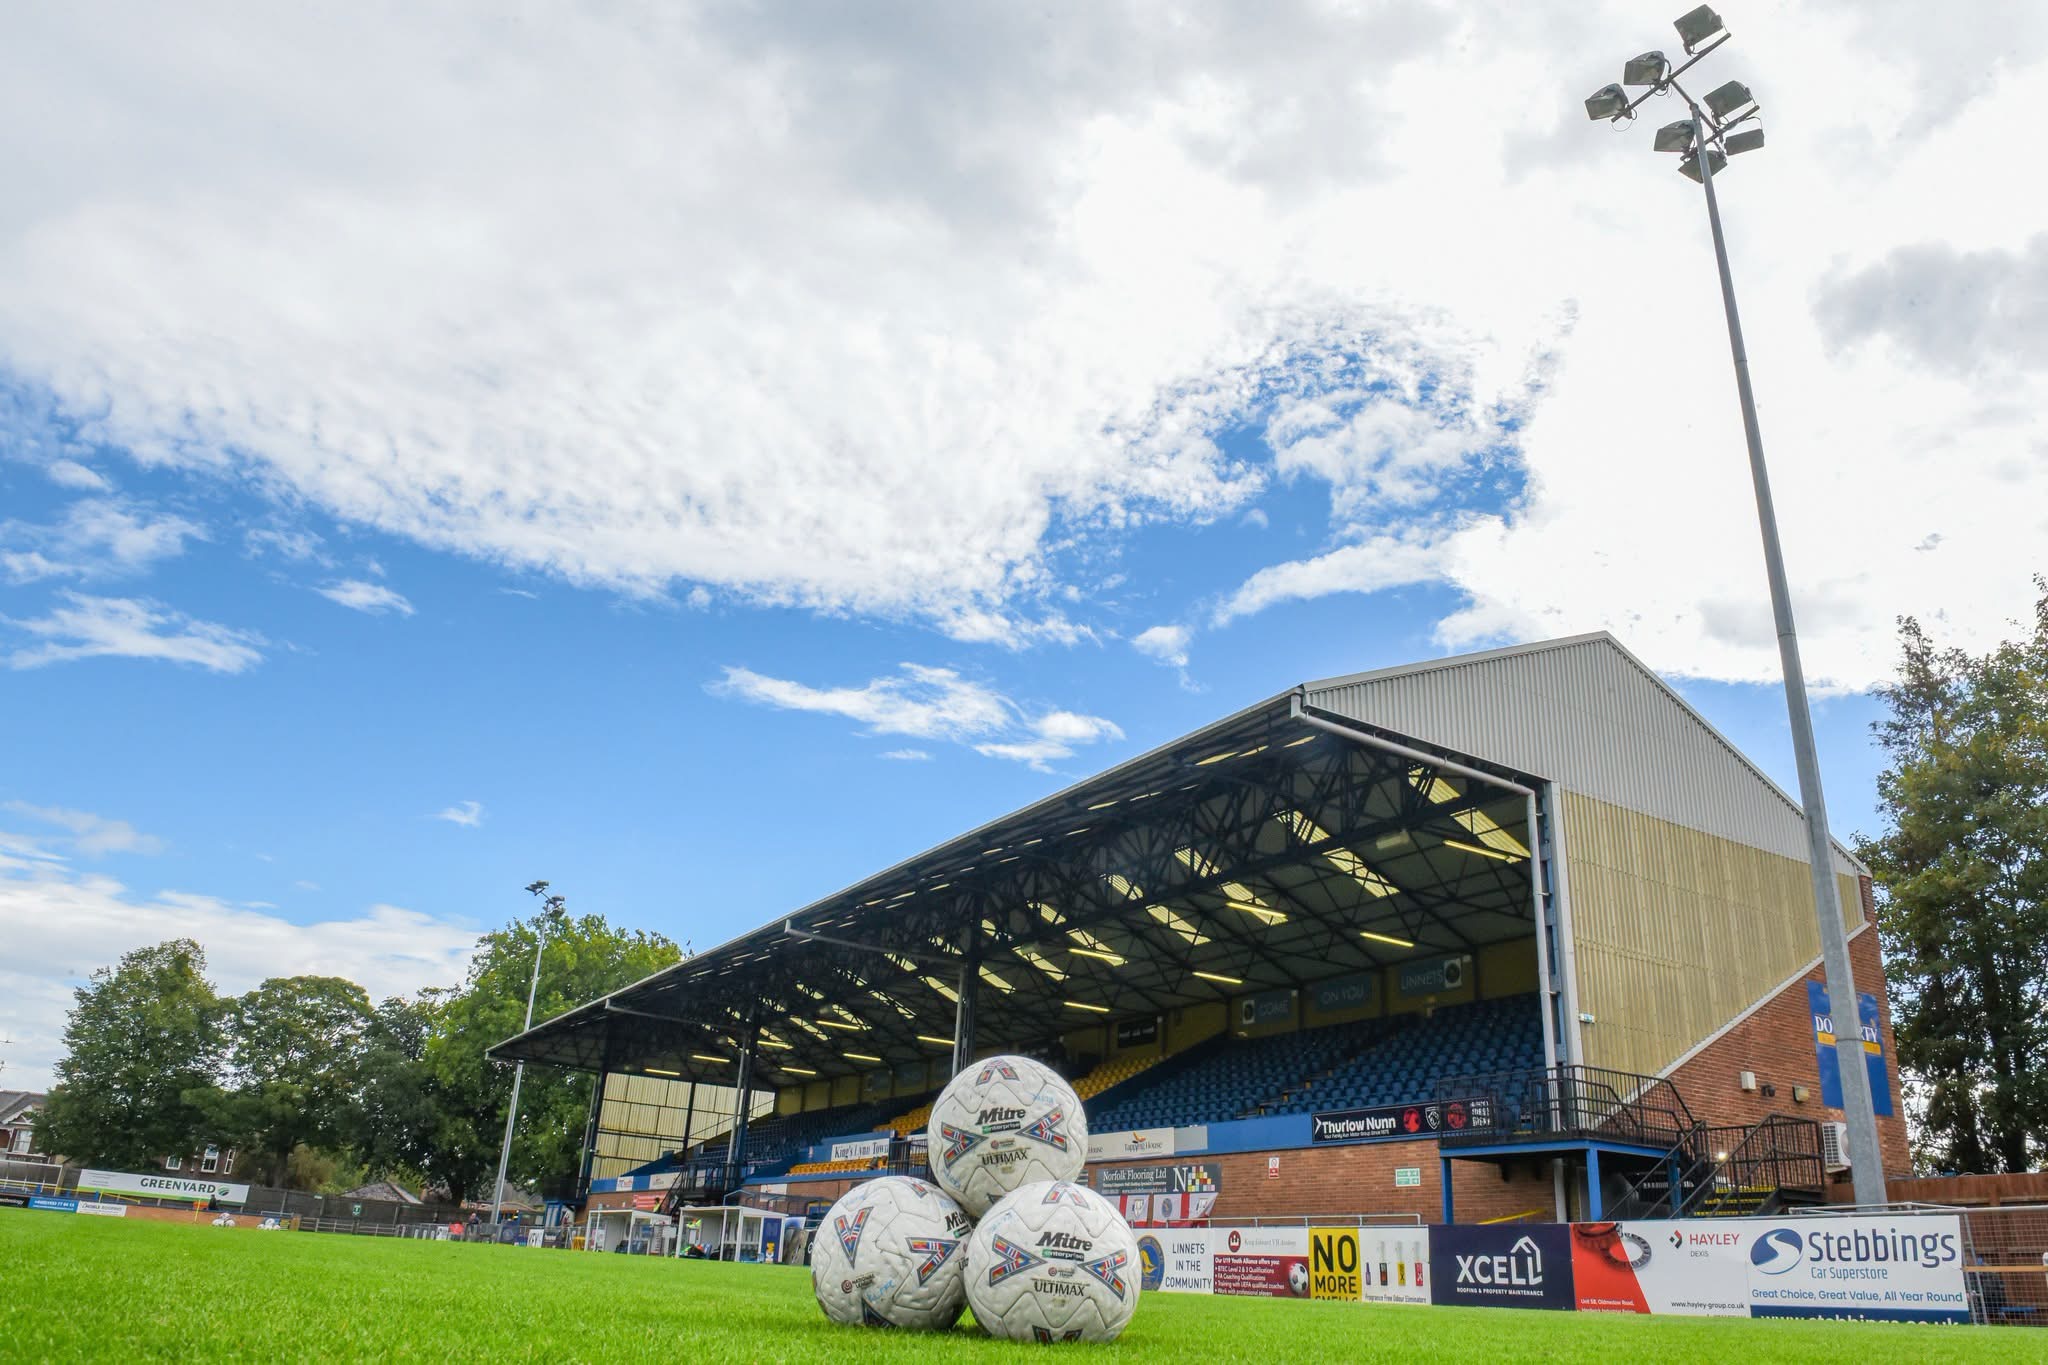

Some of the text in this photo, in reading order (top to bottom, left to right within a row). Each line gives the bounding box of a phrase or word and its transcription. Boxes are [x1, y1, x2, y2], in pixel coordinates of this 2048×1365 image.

[975, 1107, 1026, 1125] Mitre
[1322, 1117, 1396, 1134] Thurlow Nunn
[834, 1145, 853, 1158] King's
[982, 1150, 1028, 1165] ULTIMAX
[1103, 1168, 1167, 1181] Norfolk Flooring Ltd
[1173, 1167, 1188, 1192] N
[140, 1177, 216, 1193] GREENYARD
[1035, 1231, 1092, 1251] Mitre
[1689, 1233, 1740, 1246] HAYLEY
[1172, 1243, 1205, 1254] LINNETS
[1313, 1234, 1357, 1273] NO
[1808, 1228, 1957, 1269] Stebbings
[1176, 1260, 1201, 1272] IN THE
[1456, 1254, 1543, 1286] XCELL
[1811, 1267, 1888, 1281] Car Superstore
[1034, 1280, 1085, 1296] ULTIMAX
[1165, 1277, 1212, 1289] COMMUNITY
[1314, 1275, 1357, 1294] MORE
[1508, 1289, 1544, 1297] MAINTENANCE
[1752, 1288, 1963, 1303] Great Choice, Great Value, All Year Round
[1671, 1301, 1745, 1309] www.hayley-group.co.uk
